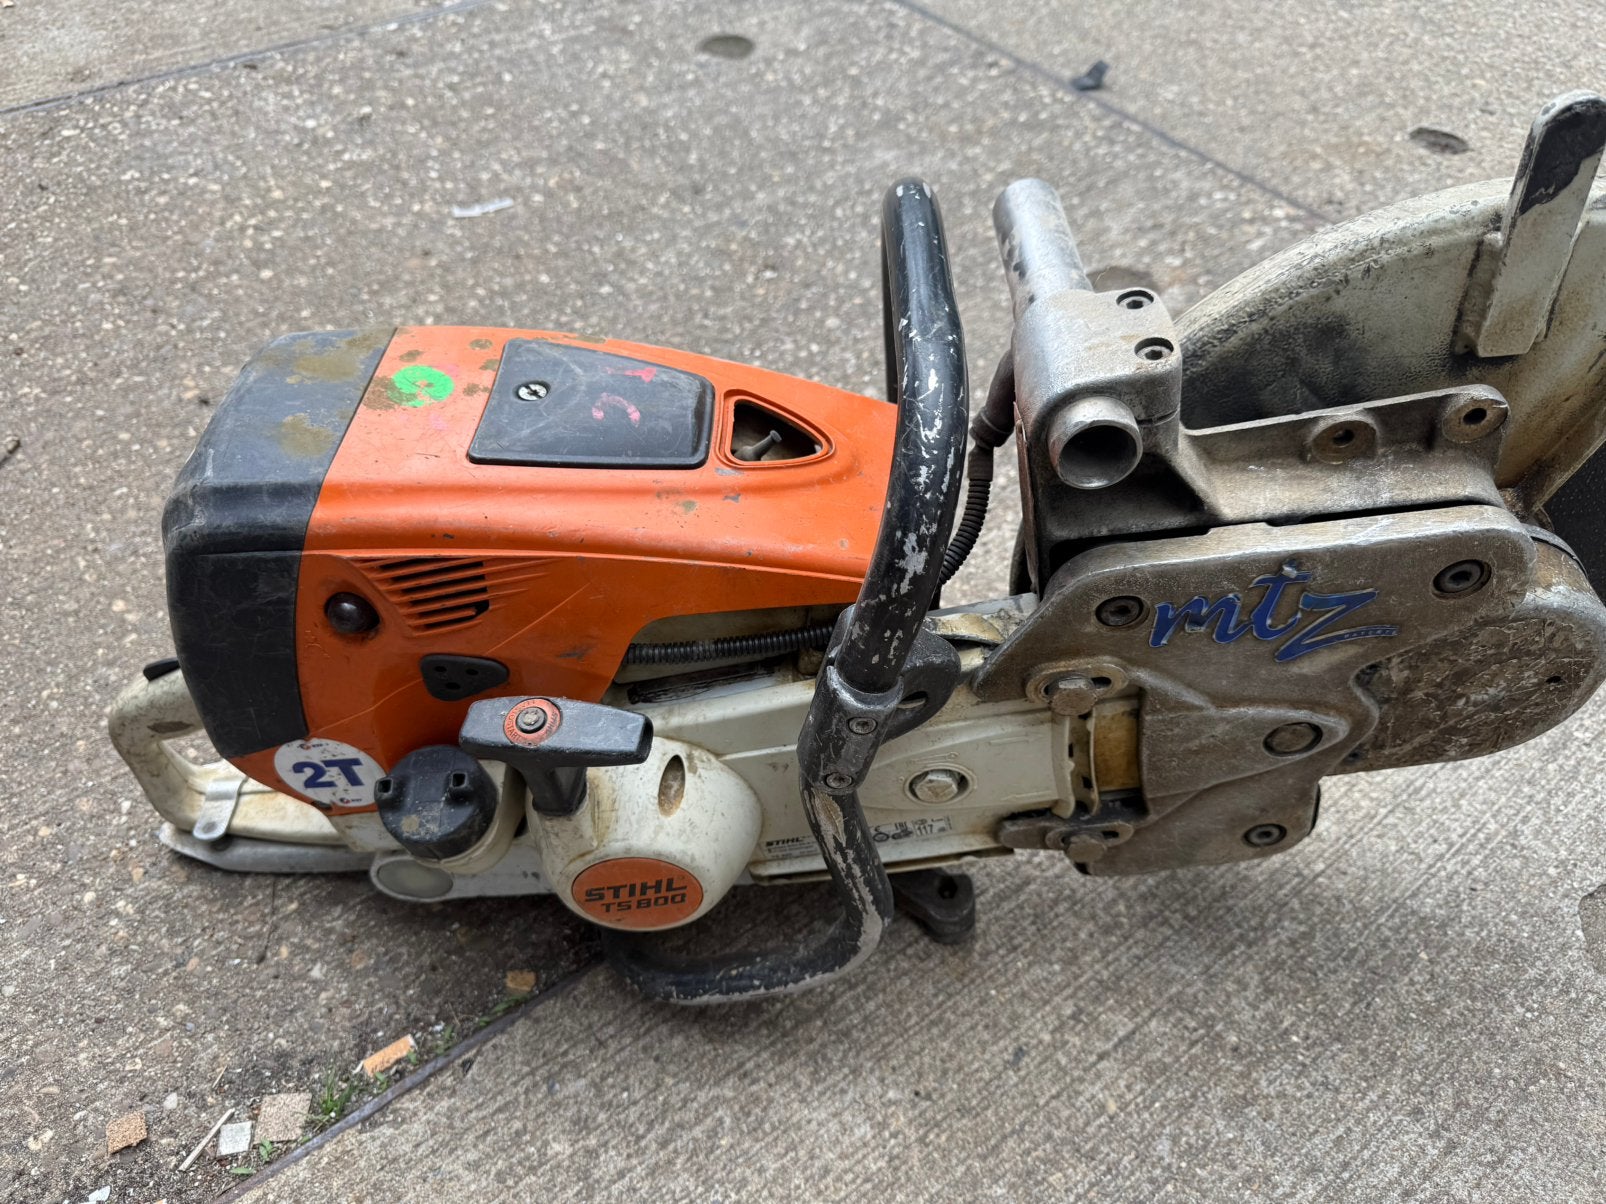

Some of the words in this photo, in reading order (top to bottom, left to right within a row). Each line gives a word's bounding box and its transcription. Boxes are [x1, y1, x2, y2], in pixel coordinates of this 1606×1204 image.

[1149, 559, 1399, 662] mtz
[292, 758, 364, 788] 2T
[765, 836, 804, 847] STIHL
[585, 878, 687, 902] STIHL
[601, 901, 632, 912] TS
[636, 893, 687, 909] 800
